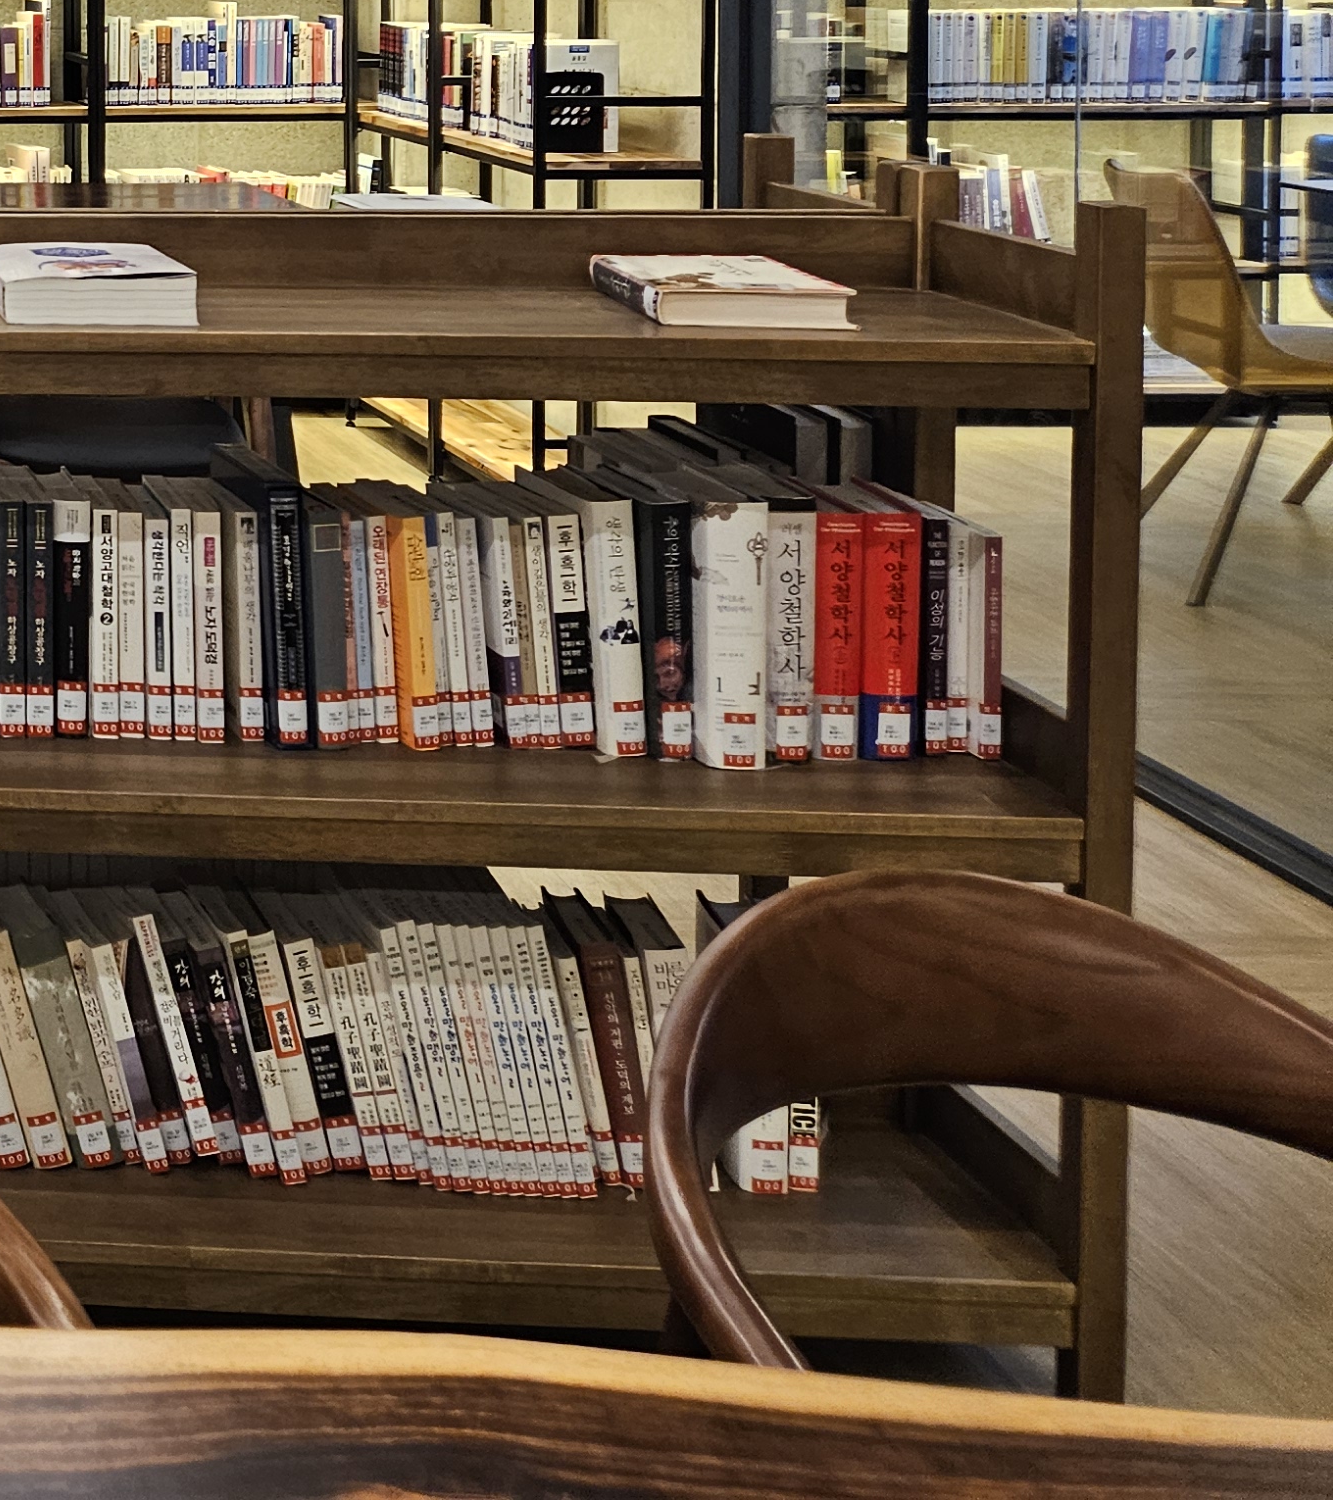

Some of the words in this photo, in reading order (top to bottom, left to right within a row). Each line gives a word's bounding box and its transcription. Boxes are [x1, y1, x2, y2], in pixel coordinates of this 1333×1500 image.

[605, 516, 624, 557] 생각의
[663, 516, 678, 541] 추의
[7, 559, 18, 577] 노자
[151, 530, 164, 581] 생각한다는
[664, 544, 681, 568] 역사
[35, 561, 46, 579] 노자
[101, 536, 113, 610] 서양고대철학
[609, 566, 627, 594] 탄생
[152, 585, 164, 605] 착각
[831, 539, 854, 646] 서양철학사
[884, 539, 908, 646] 서양철학사
[204, 606, 217, 628] 노자
[777, 539, 806, 681] 서양철학사
[928, 589, 945, 628] 이성의
[206, 630, 218, 665] 도덕경
[930, 634, 945, 662] 기능
[121, 723, 143, 731] 100
[729, 755, 752, 765] 100
[883, 745, 906, 754] 100
[174, 958, 191, 989] 강의
[209, 970, 226, 999] 강의
[1, 1154, 23, 1164] 100
[197, 1141, 217, 1150] 100
